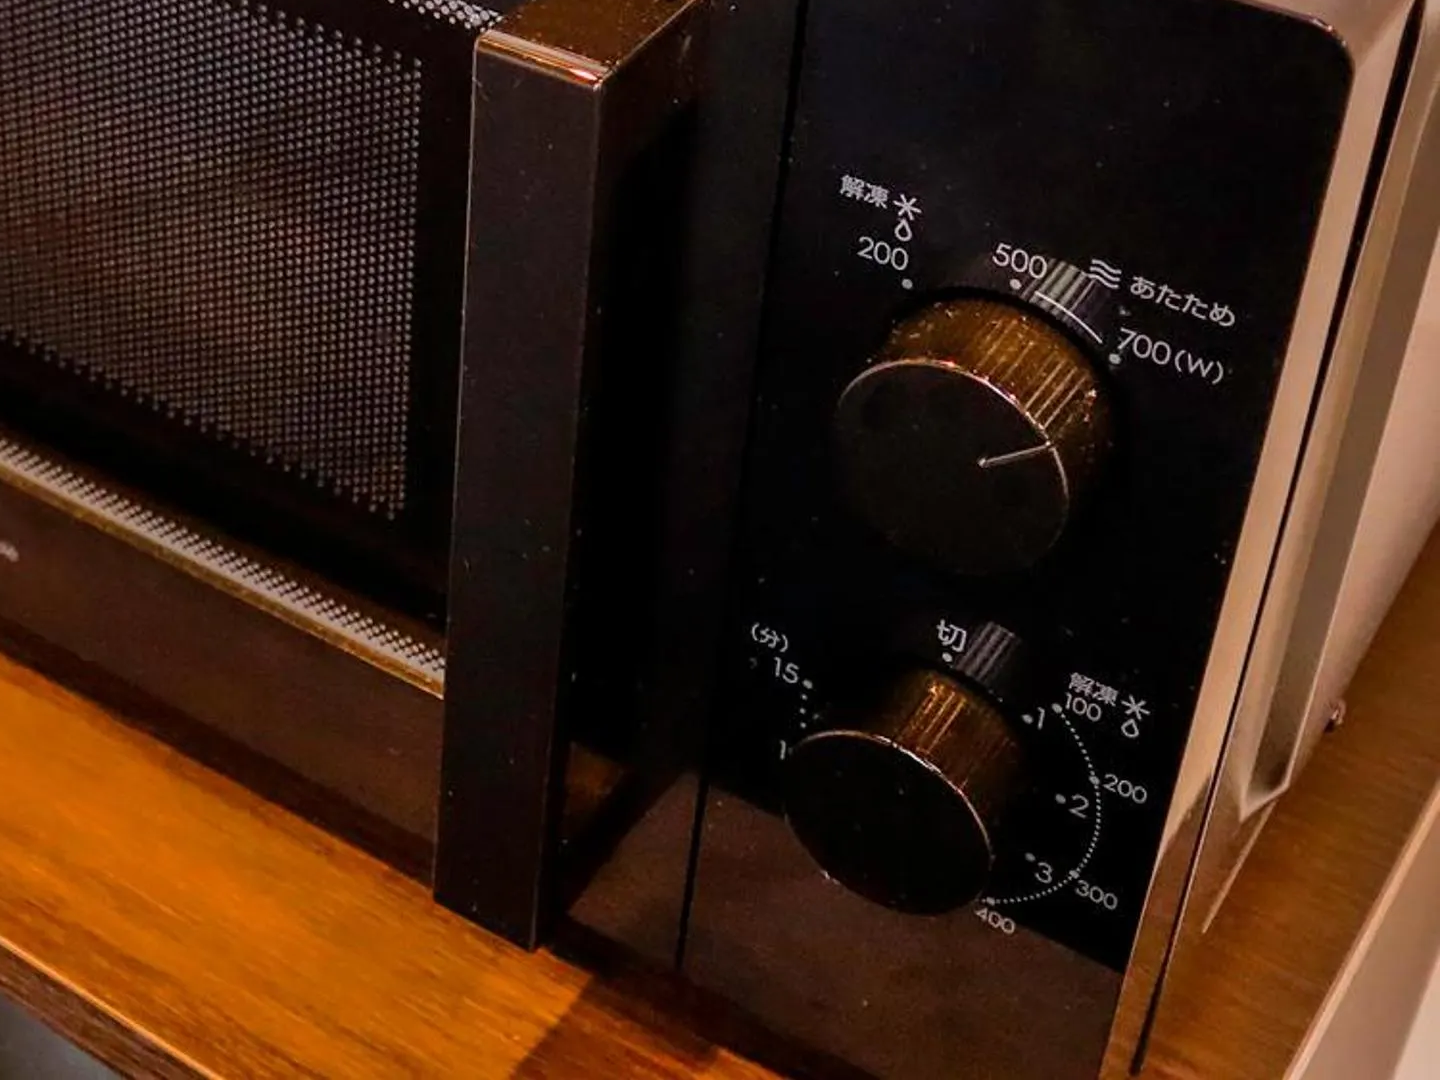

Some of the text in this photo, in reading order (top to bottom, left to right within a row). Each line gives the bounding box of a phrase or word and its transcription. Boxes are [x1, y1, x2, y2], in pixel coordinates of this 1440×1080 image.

[839, 175, 889, 209] 解凍
[857, 236, 908, 271] 200
[992, 243, 1047, 279] 500
[1129, 276, 1236, 328] あたため
[937, 619, 966, 653] 切
[773, 657, 799, 683] 15
[1069, 672, 1117, 706] 解凍
[1036, 707, 1045, 729] 1
[1065, 693, 1101, 721] 100
[1103, 774, 1147, 803] 200
[1069, 795, 1089, 818] 2
[1036, 862, 1052, 884] 3
[1075, 881, 1117, 910] 300
[974, 907, 1016, 934] 400
